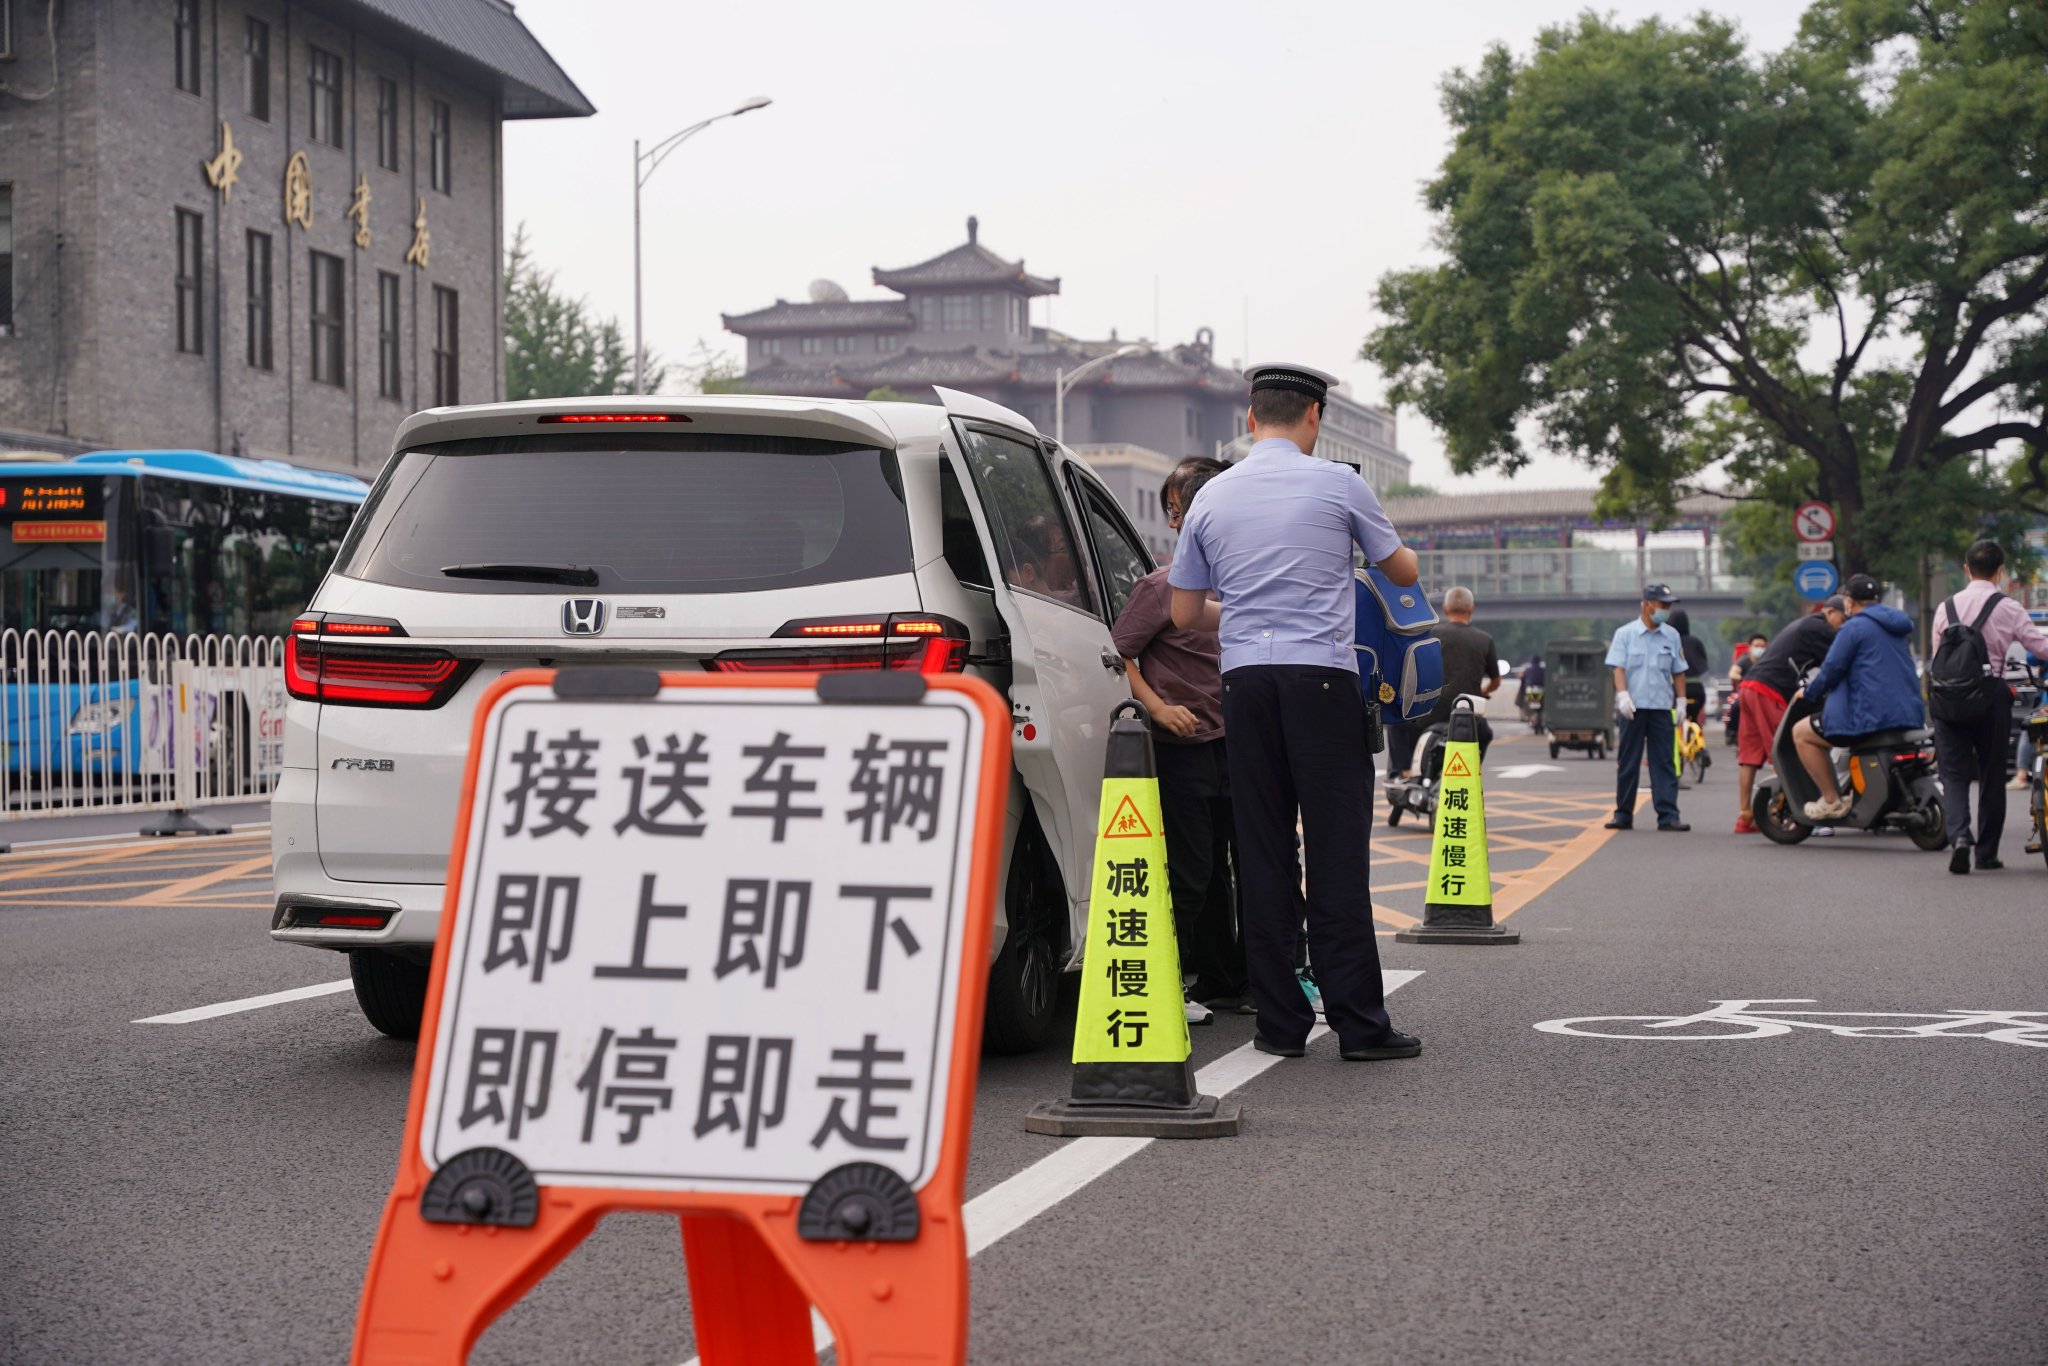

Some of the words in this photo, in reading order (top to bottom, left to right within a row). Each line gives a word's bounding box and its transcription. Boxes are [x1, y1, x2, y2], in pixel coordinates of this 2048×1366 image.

[331, 757, 394, 771] 广汽本田
[502, 729, 950, 844] 接送车辆
[1439, 787, 1469, 896] 减速慢行
[482, 873, 934, 993] 即上即下
[1105, 858, 1150, 1048] 减速慢行
[457, 1025, 913, 1152] 即停即走
